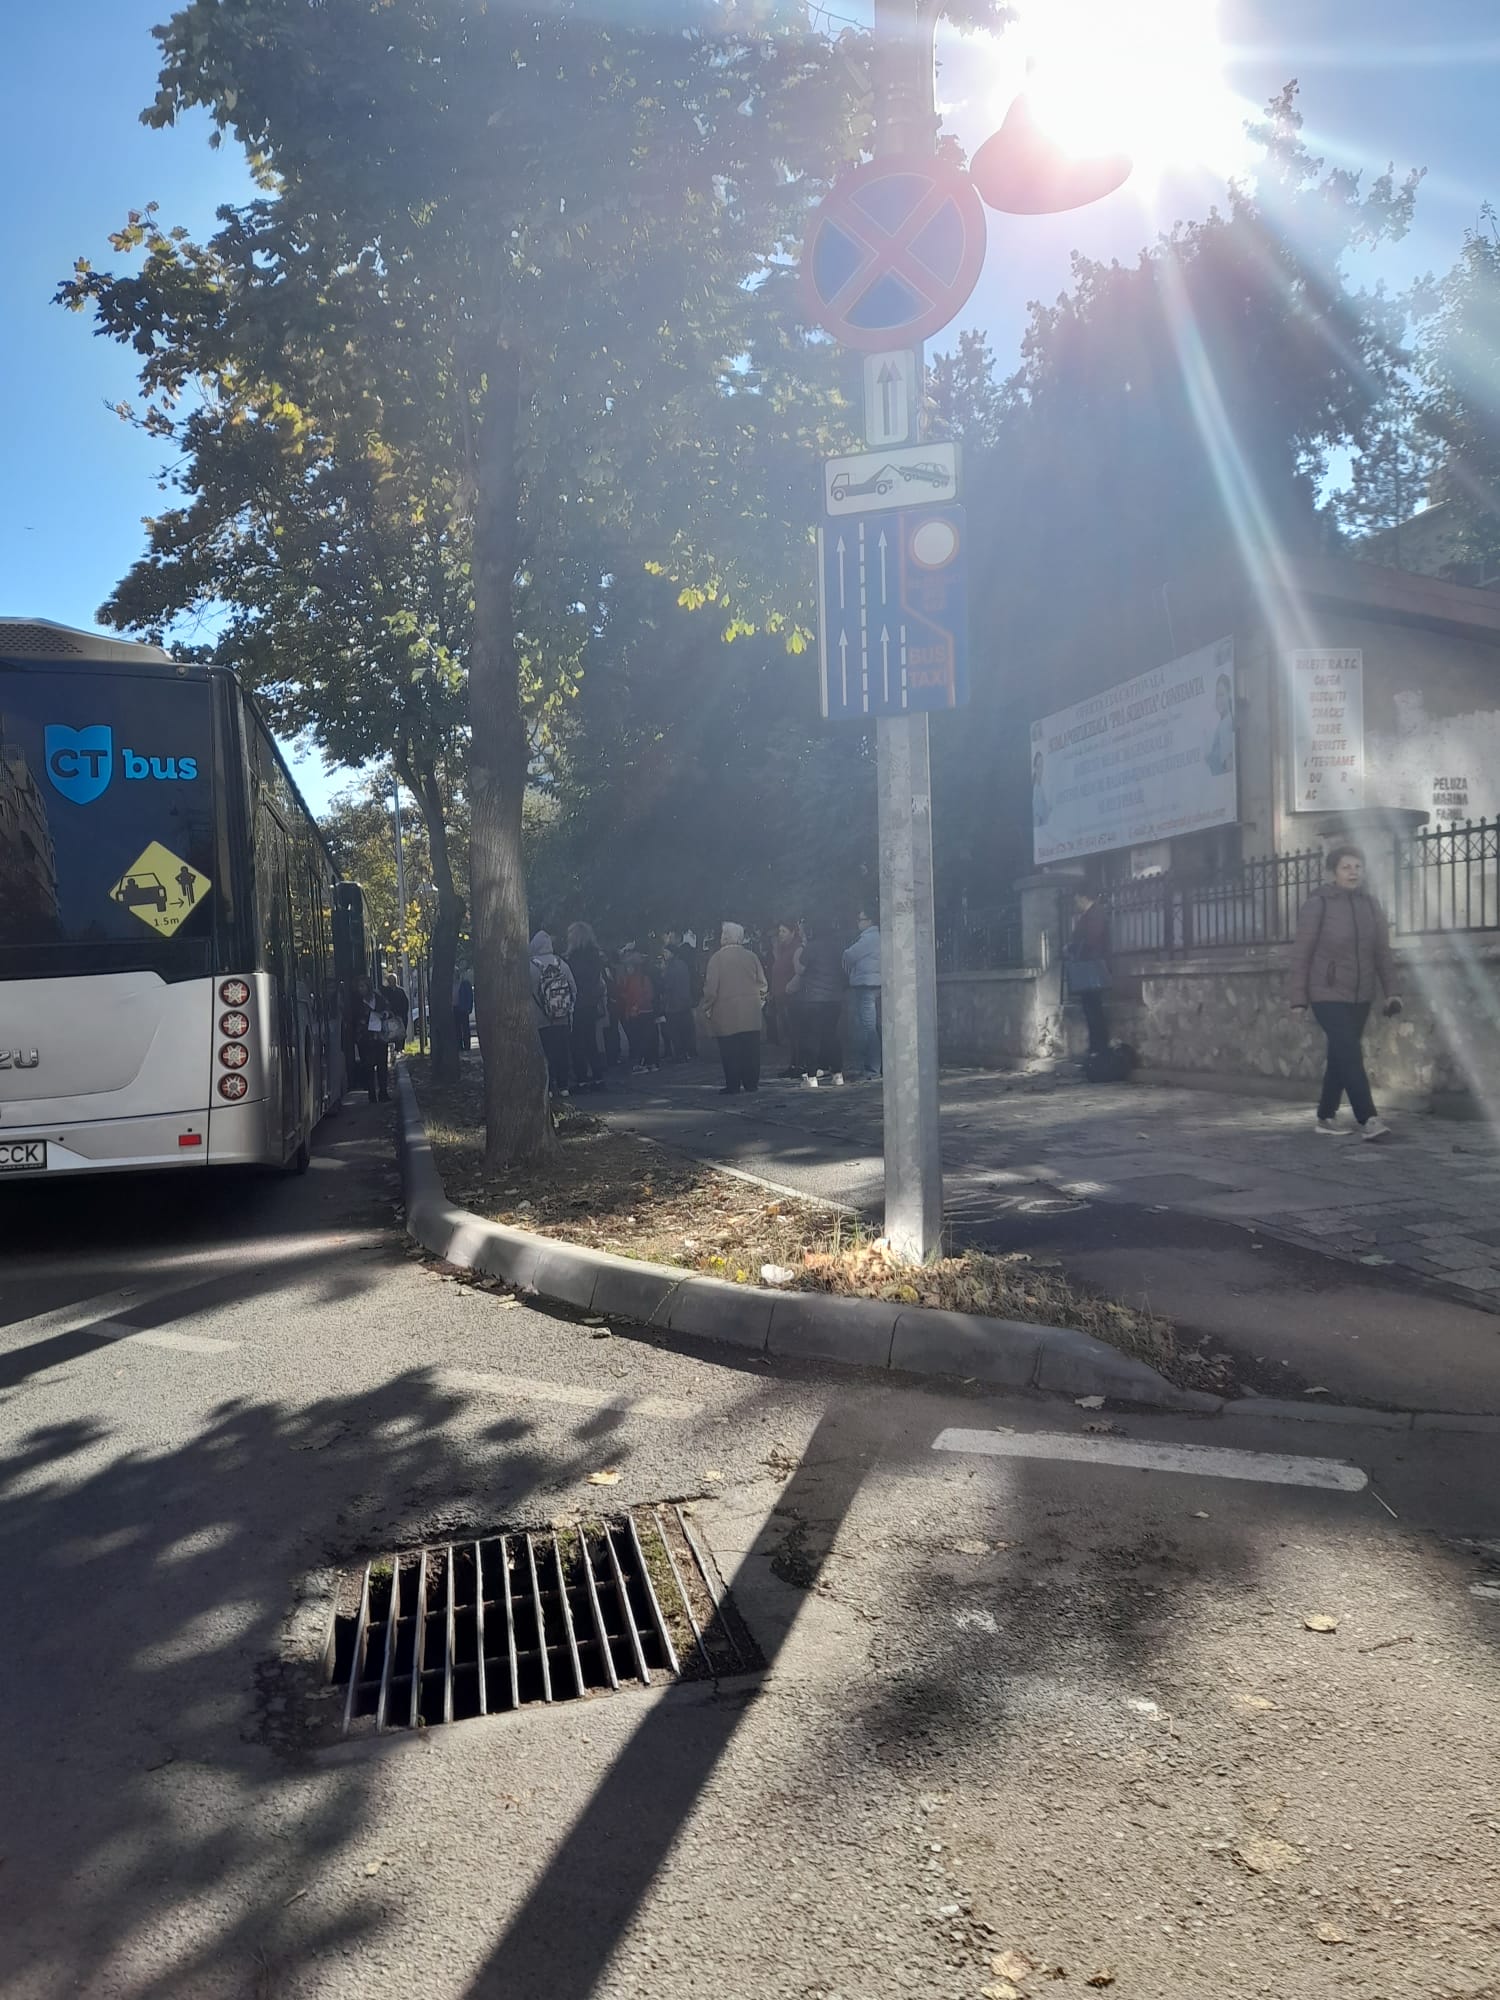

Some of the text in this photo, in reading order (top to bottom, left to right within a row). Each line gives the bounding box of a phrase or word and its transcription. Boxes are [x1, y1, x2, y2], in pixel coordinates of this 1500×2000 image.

[910, 645, 945, 664] BUS
[51, 748, 198, 780] CT bus
[1433, 776, 1468, 791] PELUZA
[154, 917, 180, 927] 1.5m
